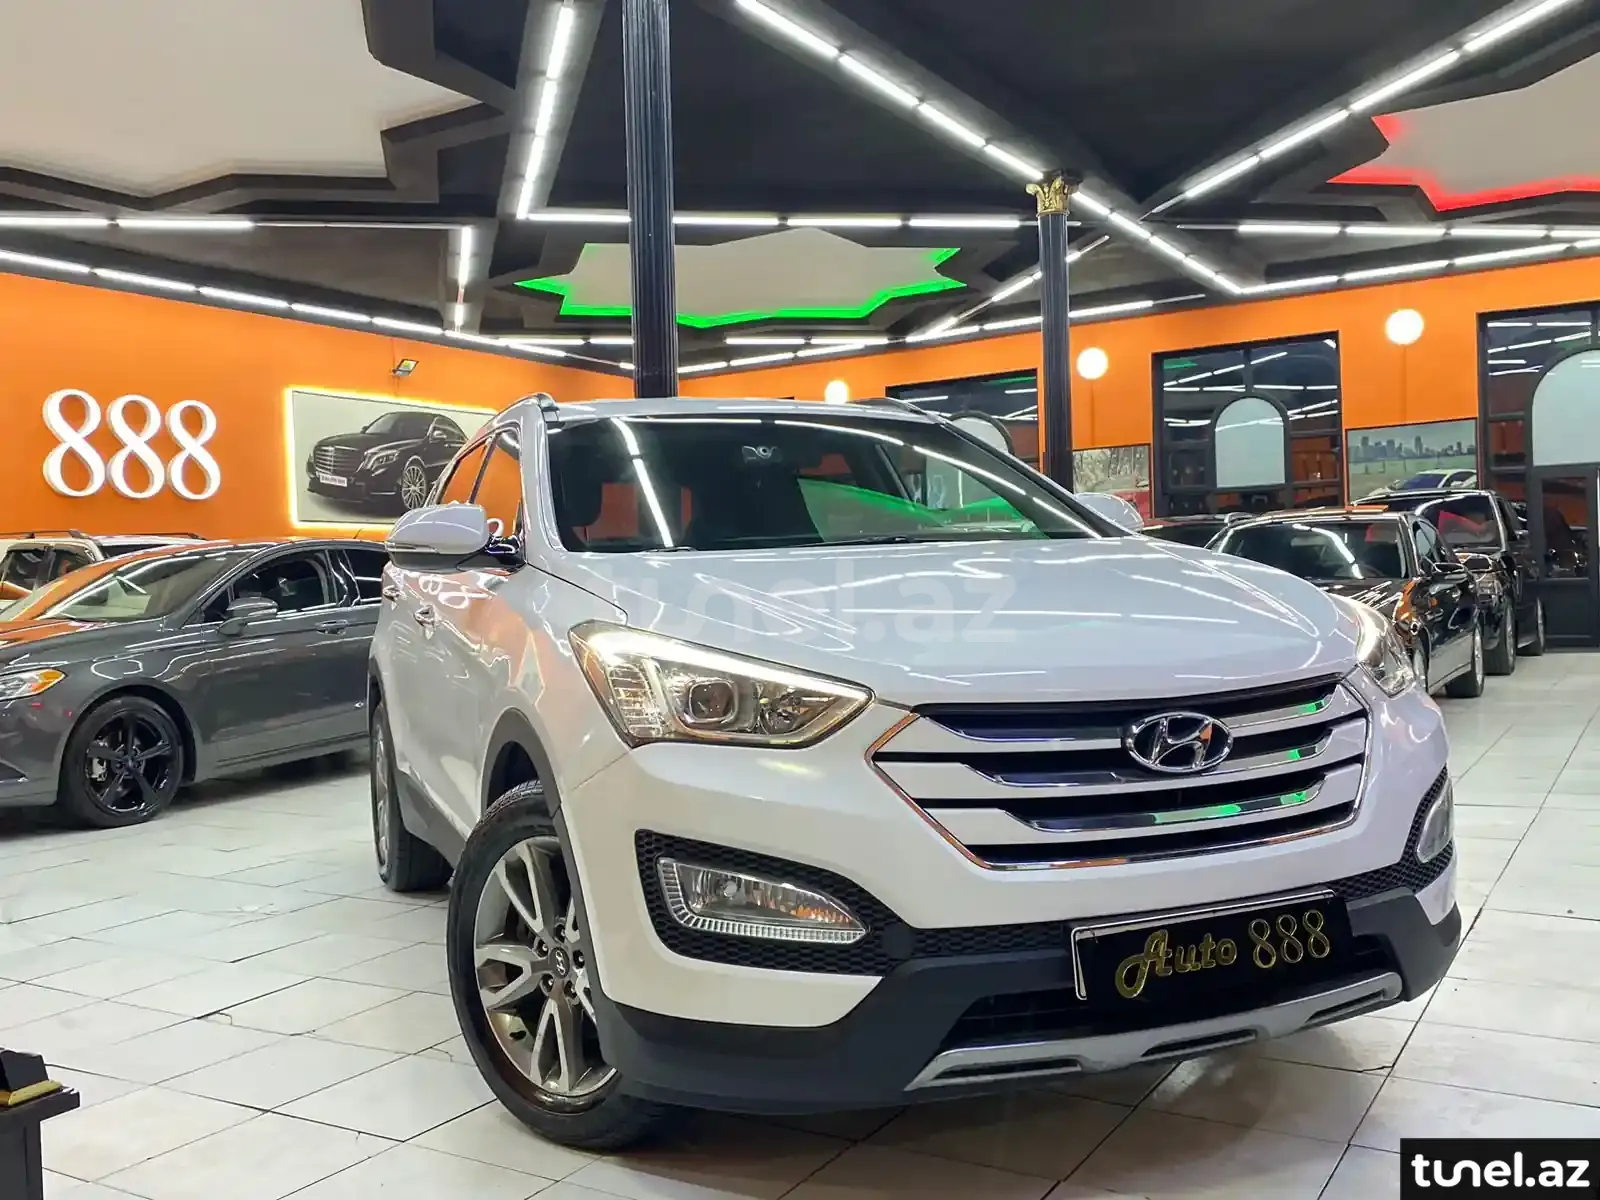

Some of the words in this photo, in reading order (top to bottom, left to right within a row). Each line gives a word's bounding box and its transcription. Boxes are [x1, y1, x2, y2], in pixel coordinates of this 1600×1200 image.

[42, 388, 221, 501] 888
[1115, 928, 1237, 999] Auto
[1249, 909, 1330, 968] 888
